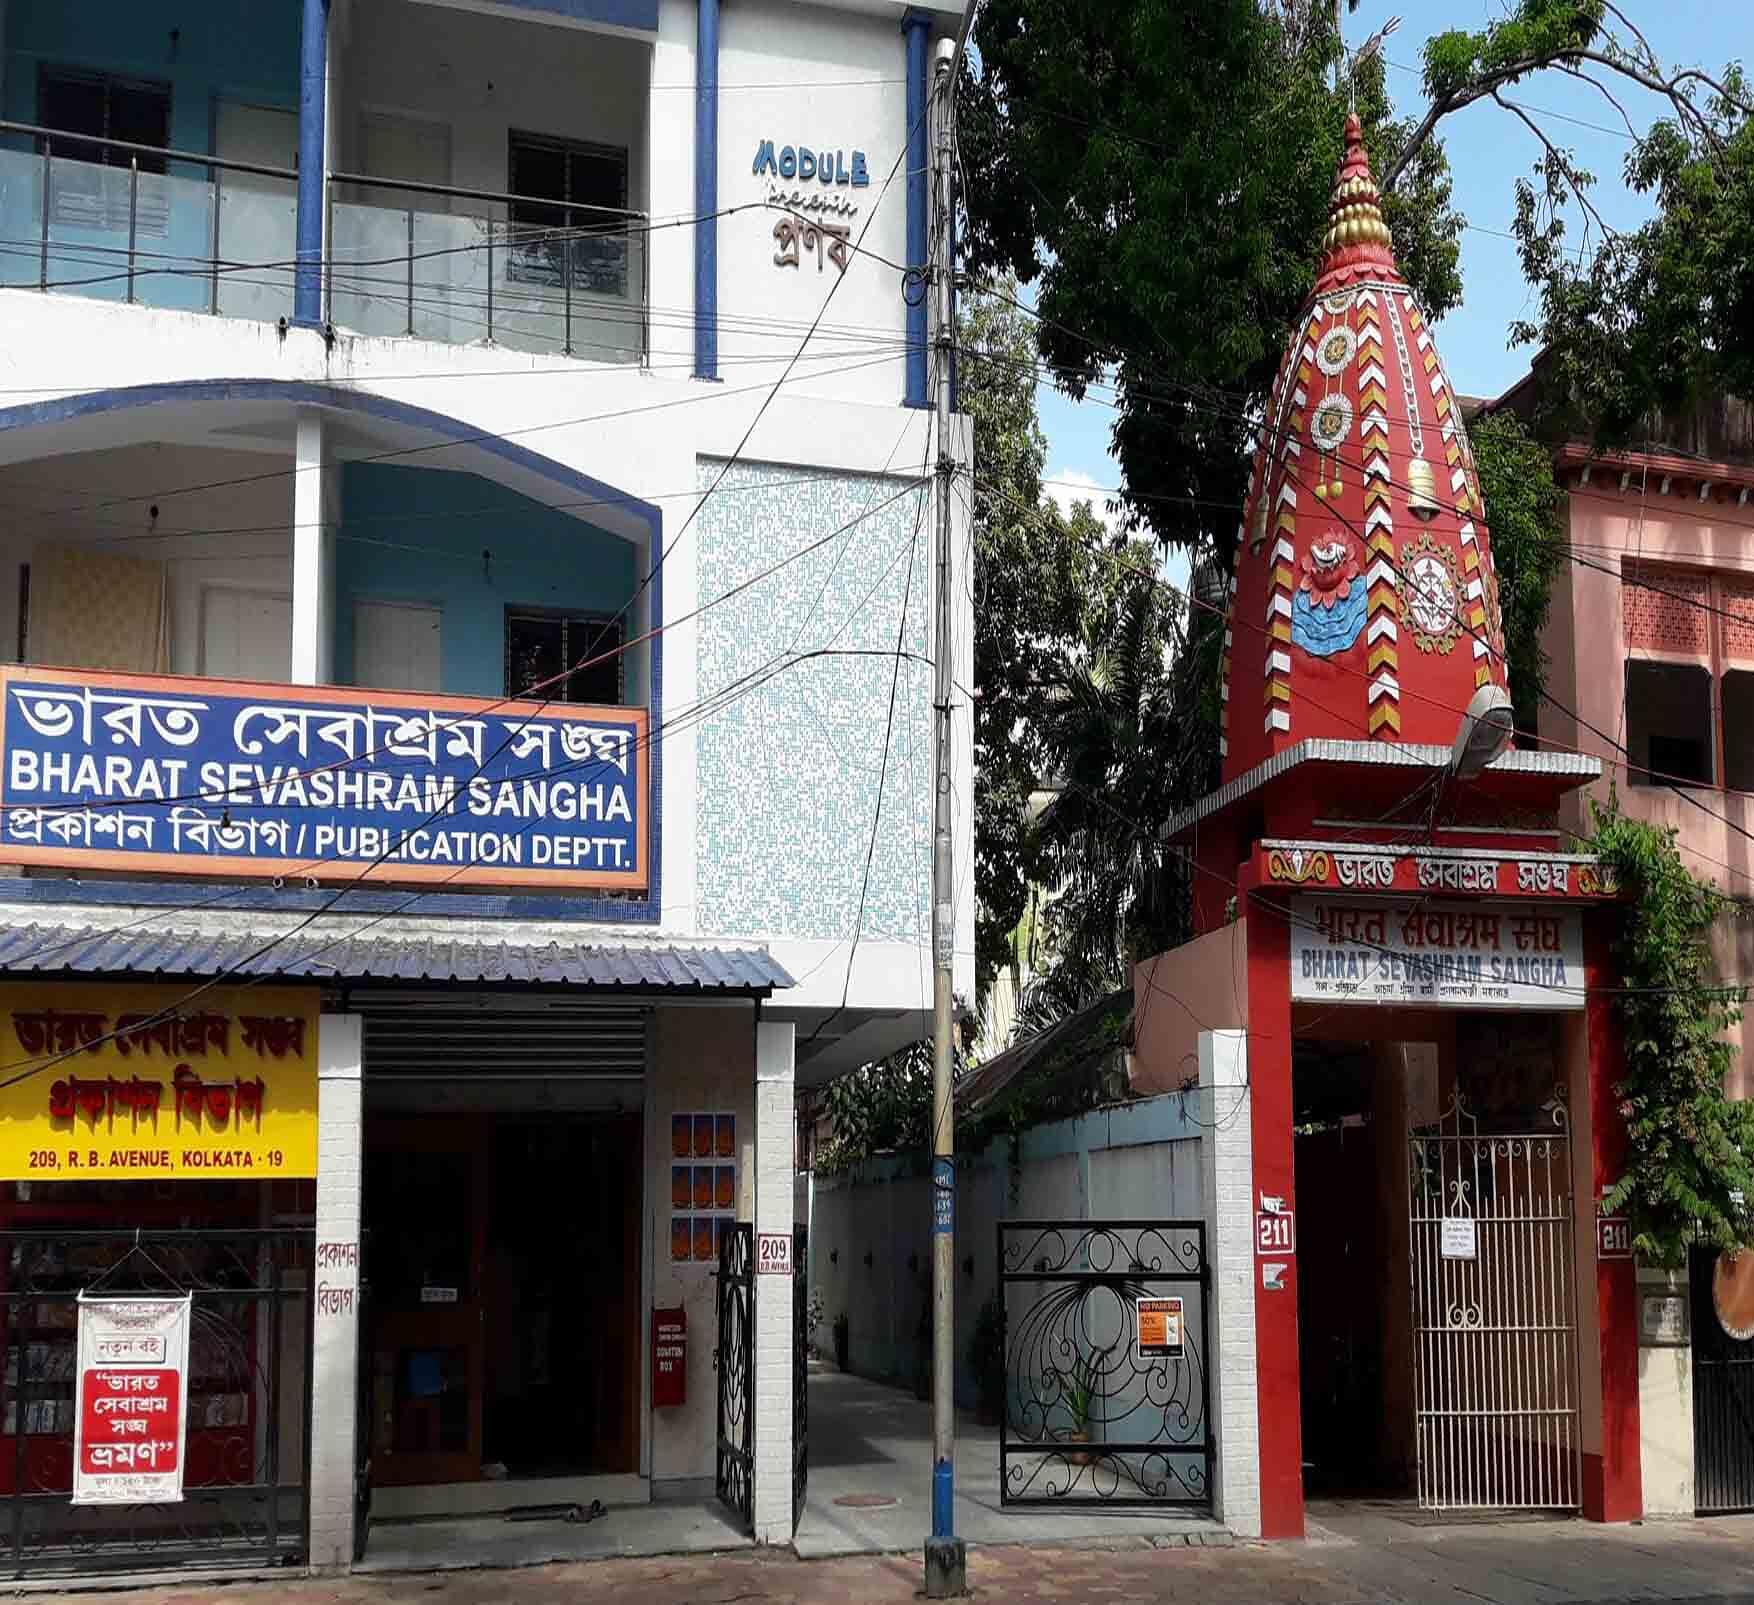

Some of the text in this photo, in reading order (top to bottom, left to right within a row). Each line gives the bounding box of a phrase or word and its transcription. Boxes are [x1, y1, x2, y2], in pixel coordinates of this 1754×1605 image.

[752, 140, 870, 188] MODULE
[773, 214, 850, 273] প্রণব
[9, 687, 633, 776] ভারত সেবাশ্রম সঙ্ঘ
[11, 750, 633, 822] BHARAT SEVASHRAM SANGHA
[9, 808, 155, 848] প্রকাশন
[167, 806, 290, 854] বিভাগ
[315, 825, 521, 864] PUBLICATION
[532, 836, 631, 867] DEPTT.
[1334, 854, 1395, 886] ভারত
[1416, 857, 1499, 890] সেবাশ্রম
[1313, 903, 1388, 944] भारत
[1509, 908, 1563, 951] संघ
[1302, 949, 1567, 986] BHARAT SEVASHRAM SANGHA
[11, 1008, 107, 1056] ভারত
[114, 1010, 229, 1056] সেবাশ্রম
[49, 1063, 265, 1135] প্রকাশন বিভাগ
[29, 1151, 61, 1171] 209,
[109, 1150, 174, 1171] AVENUE,
[182, 1151, 252, 1167] KOLKATA
[267, 1150, 283, 1166] 19
[762, 1240, 786, 1259] 209
[1260, 1220, 1288, 1245] 211
[1603, 1225, 1627, 1249] 211
[318, 1243, 357, 1268] প্রকাশন
[318, 1281, 353, 1316] বিভাগ
[96, 1372, 159, 1391] “ভারত
[94, 1396, 168, 1413] সেবাশ্রম
[88, 1440, 174, 1468] ভ্রমণ”
